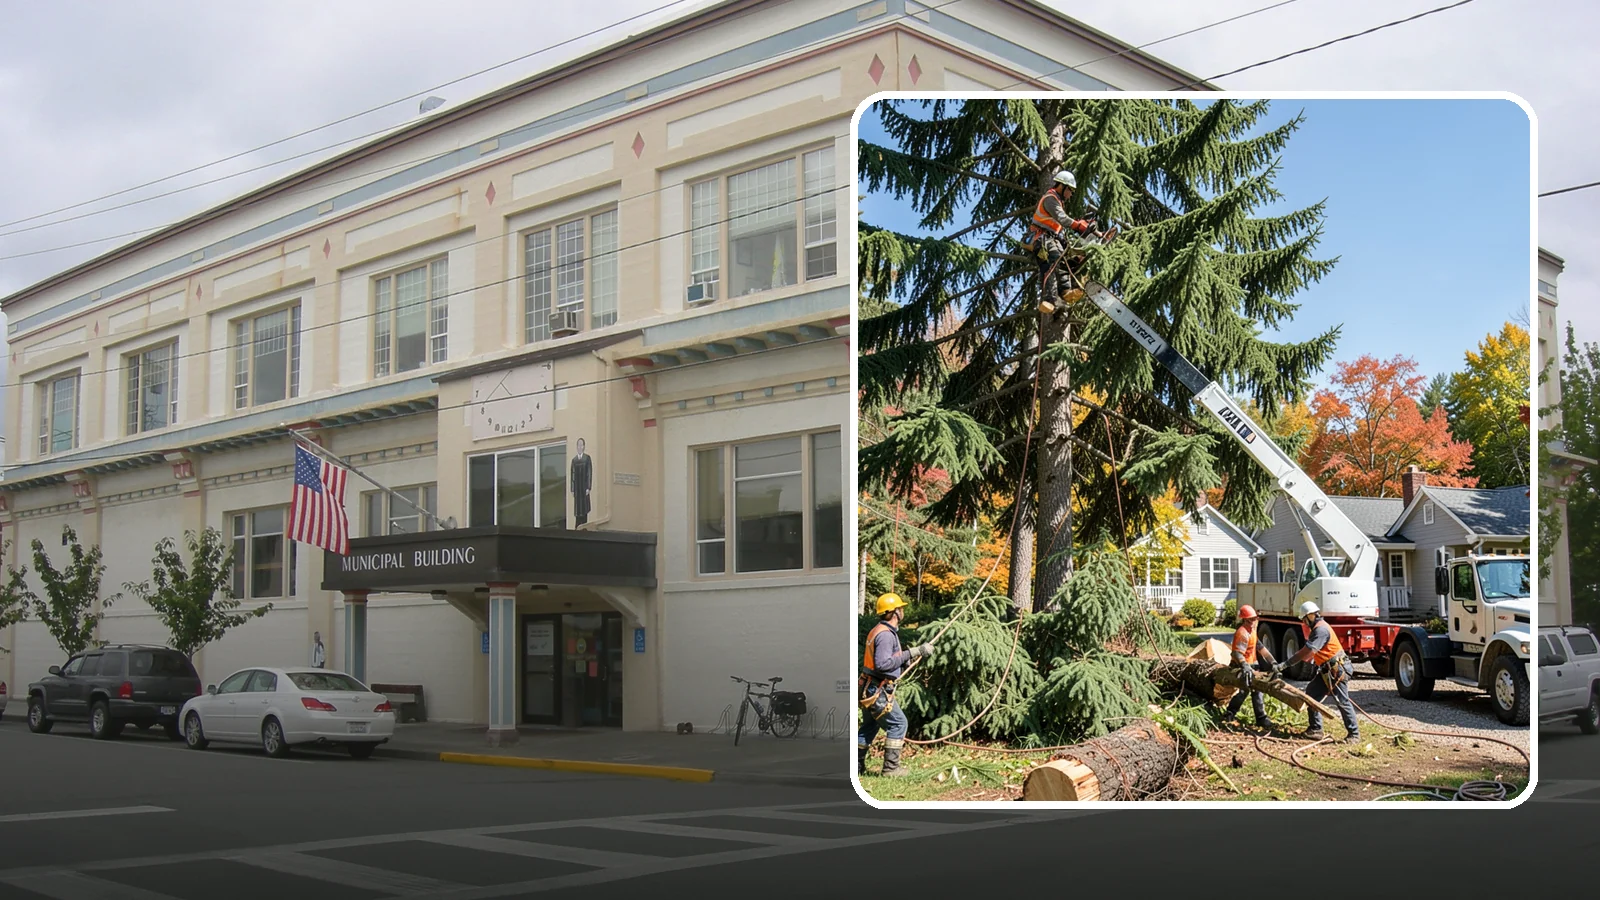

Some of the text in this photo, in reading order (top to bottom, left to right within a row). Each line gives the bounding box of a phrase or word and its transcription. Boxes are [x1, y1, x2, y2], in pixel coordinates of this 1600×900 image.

[536, 402, 540, 410] 4
[480, 407, 485, 415] 8
[488, 418, 492, 426] 9
[529, 414, 533, 422] 3
[495, 424, 500, 432] 10
[508, 425, 513, 433] 12
[342, 546, 475, 572] MUNICIPAL BUILDING
